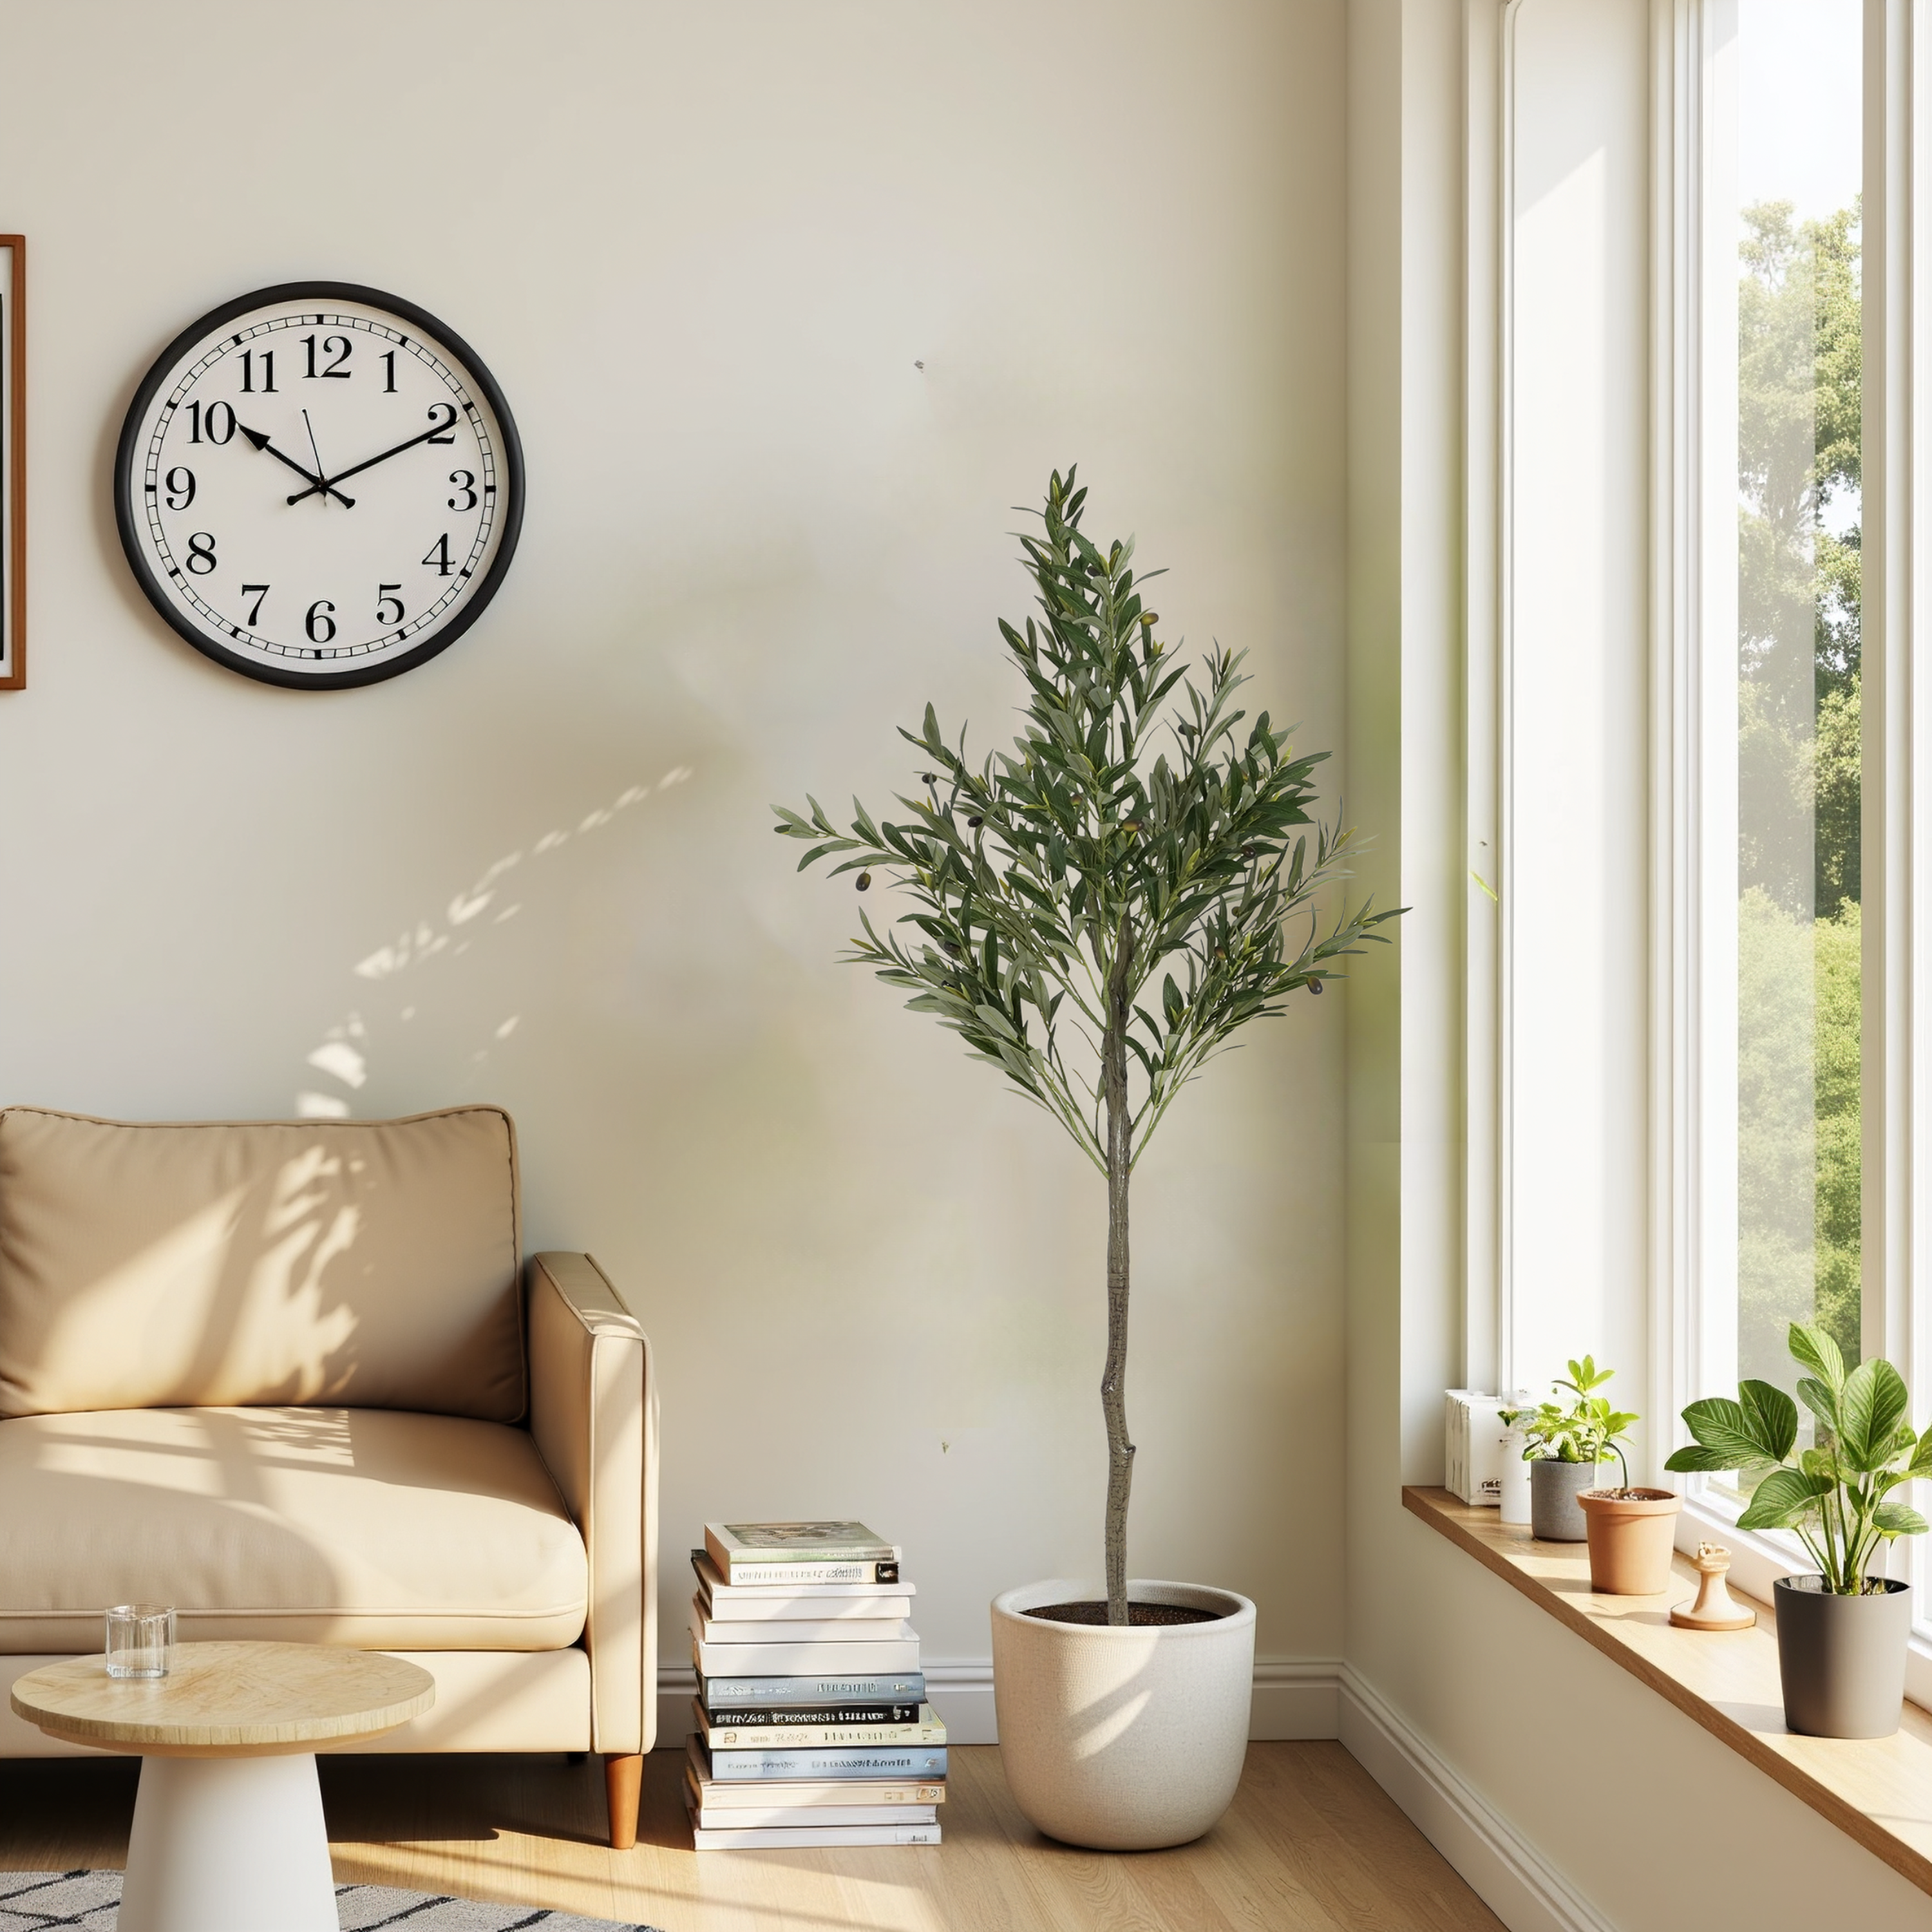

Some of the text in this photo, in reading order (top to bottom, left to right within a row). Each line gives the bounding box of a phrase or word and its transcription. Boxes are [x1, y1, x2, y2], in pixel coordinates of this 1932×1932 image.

[236, 350, 279, 392] 11
[300, 334, 352, 379] 12
[379, 350, 398, 392] 1
[185, 399, 236, 444] 10
[428, 403, 458, 444] 2
[166, 467, 195, 510] 9
[448, 470, 477, 511] 3
[186, 533, 216, 574] 8
[422, 533, 456, 576] 4
[241, 584, 270, 625] 7
[306, 601, 336, 643] 6
[377, 584, 405, 625] 5
